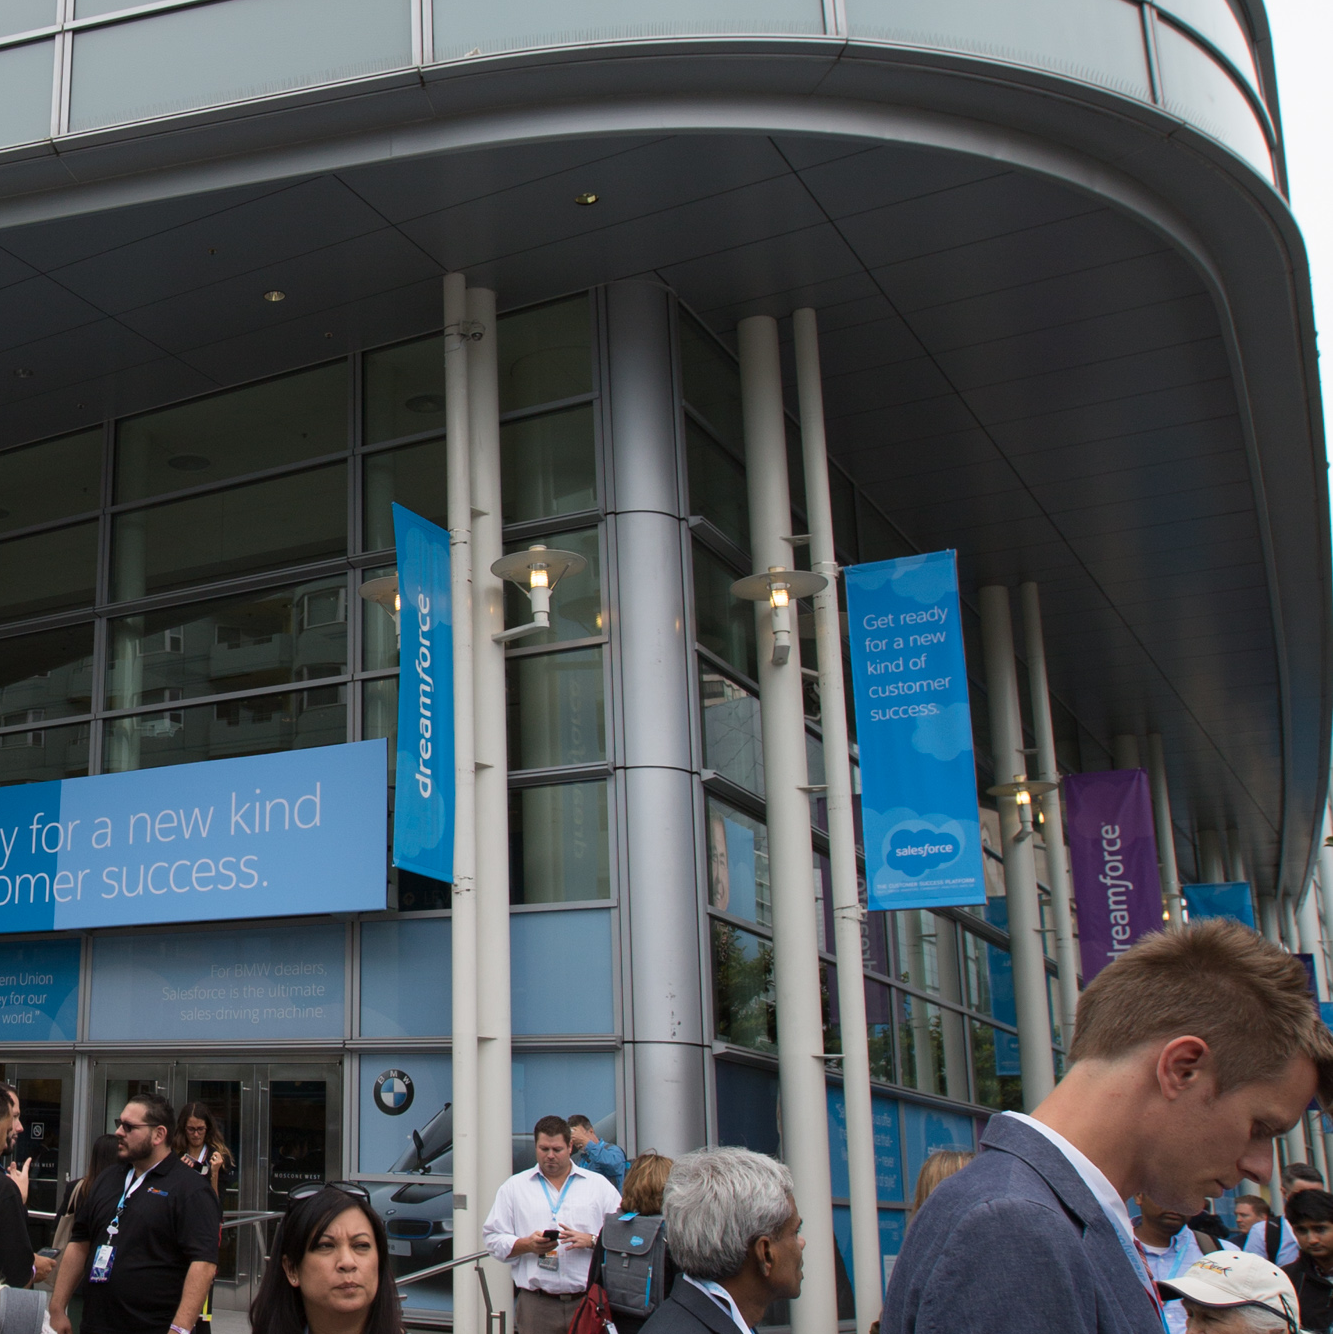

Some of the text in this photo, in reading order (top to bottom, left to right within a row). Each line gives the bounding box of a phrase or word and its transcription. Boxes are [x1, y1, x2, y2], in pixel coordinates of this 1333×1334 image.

[863, 605, 948, 630] Get ready
[865, 631, 946, 653] for a new
[867, 653, 927, 675] kind of
[416, 593, 434, 799] dreamforce
[868, 676, 952, 698] customer
[870, 703, 940, 721] success.
[29, 812, 80, 855] for
[91, 817, 112, 849] a
[129, 806, 214, 845] new
[230, 781, 321, 836] kind
[895, 843, 953, 857] salesforce
[100, 854, 269, 899] success.
[19, 972, 53, 985] Union
[211, 964, 231, 978] For
[234, 963, 271, 977] BMW
[9, 992, 25, 1005] for
[27, 993, 47, 1004] our
[162, 983, 325, 1001] Salesforce is the ultimate
[180, 1006, 260, 1024] sales-driving
[377, 1070, 411, 1085] BMW
